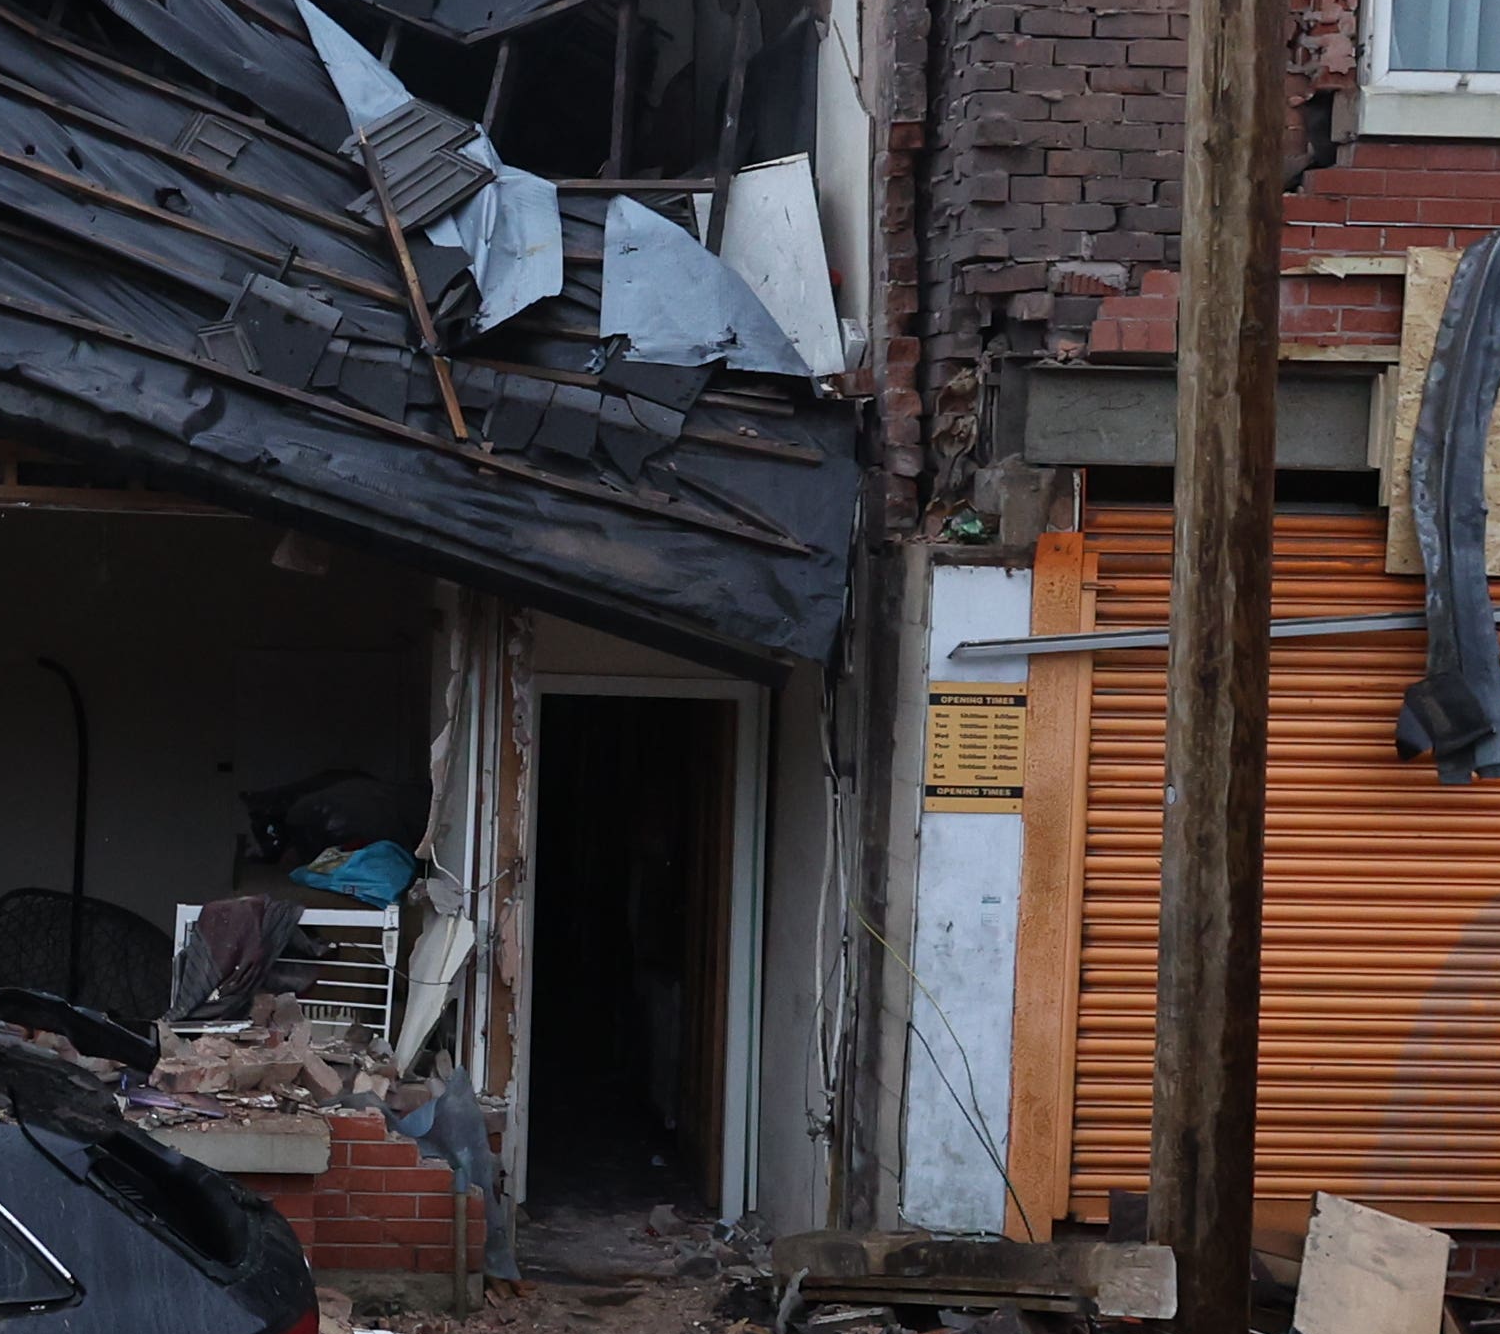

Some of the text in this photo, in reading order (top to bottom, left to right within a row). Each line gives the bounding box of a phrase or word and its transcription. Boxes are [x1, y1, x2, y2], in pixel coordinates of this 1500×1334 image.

[940, 696, 1015, 705] OPENING TIMES
[936, 788, 1012, 796] OPENING TIMES
